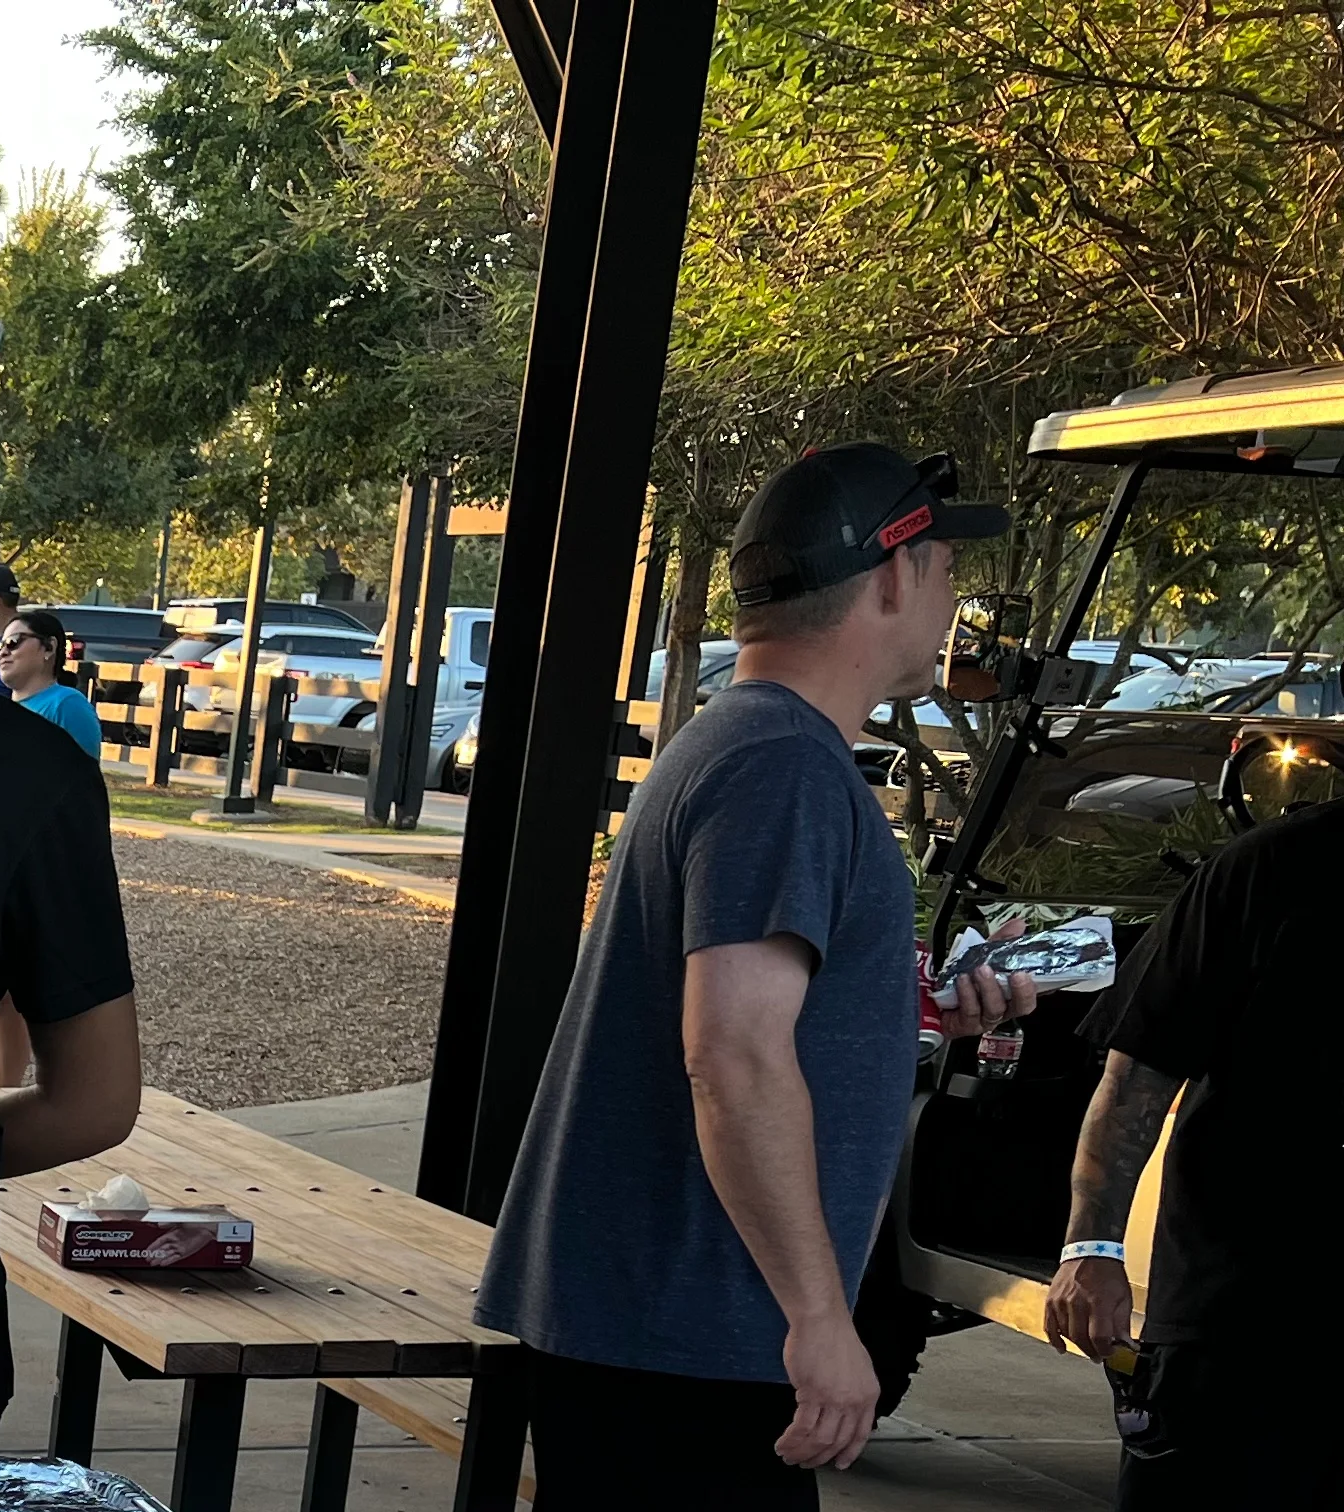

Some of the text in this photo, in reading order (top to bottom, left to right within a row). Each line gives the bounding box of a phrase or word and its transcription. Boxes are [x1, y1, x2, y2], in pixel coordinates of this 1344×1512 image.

[885, 510, 930, 544] ASTROS
[231, 1225, 239, 1235] L
[71, 1248, 166, 1259] CLEAR VINYL GLOVES
